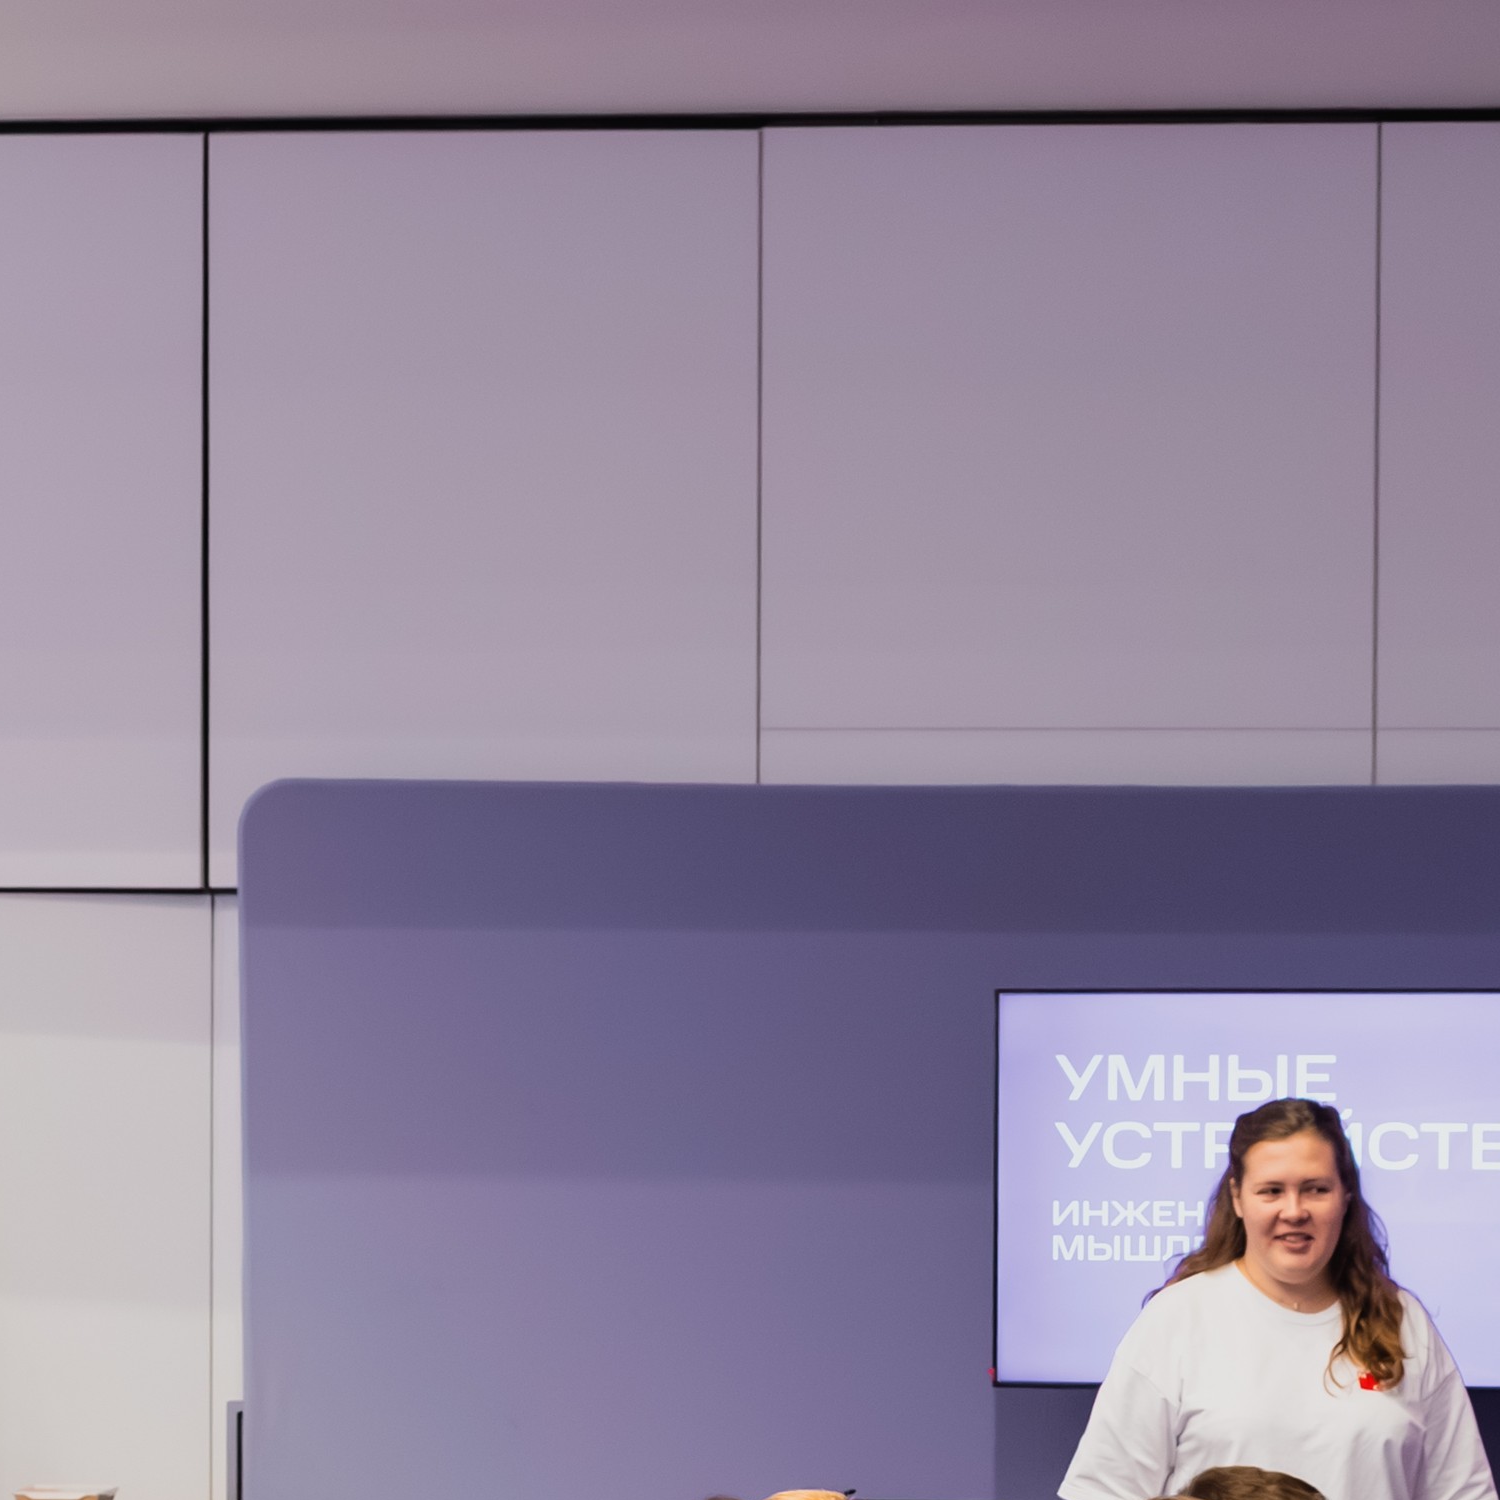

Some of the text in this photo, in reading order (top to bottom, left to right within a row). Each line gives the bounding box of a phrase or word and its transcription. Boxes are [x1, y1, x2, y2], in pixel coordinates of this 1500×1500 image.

[1055, 1053, 1337, 1102] УМНЫЕ
[1053, 1200, 1205, 1227] ИНЖЕН
[1052, 1235, 1205, 1262] МЫШЛ
